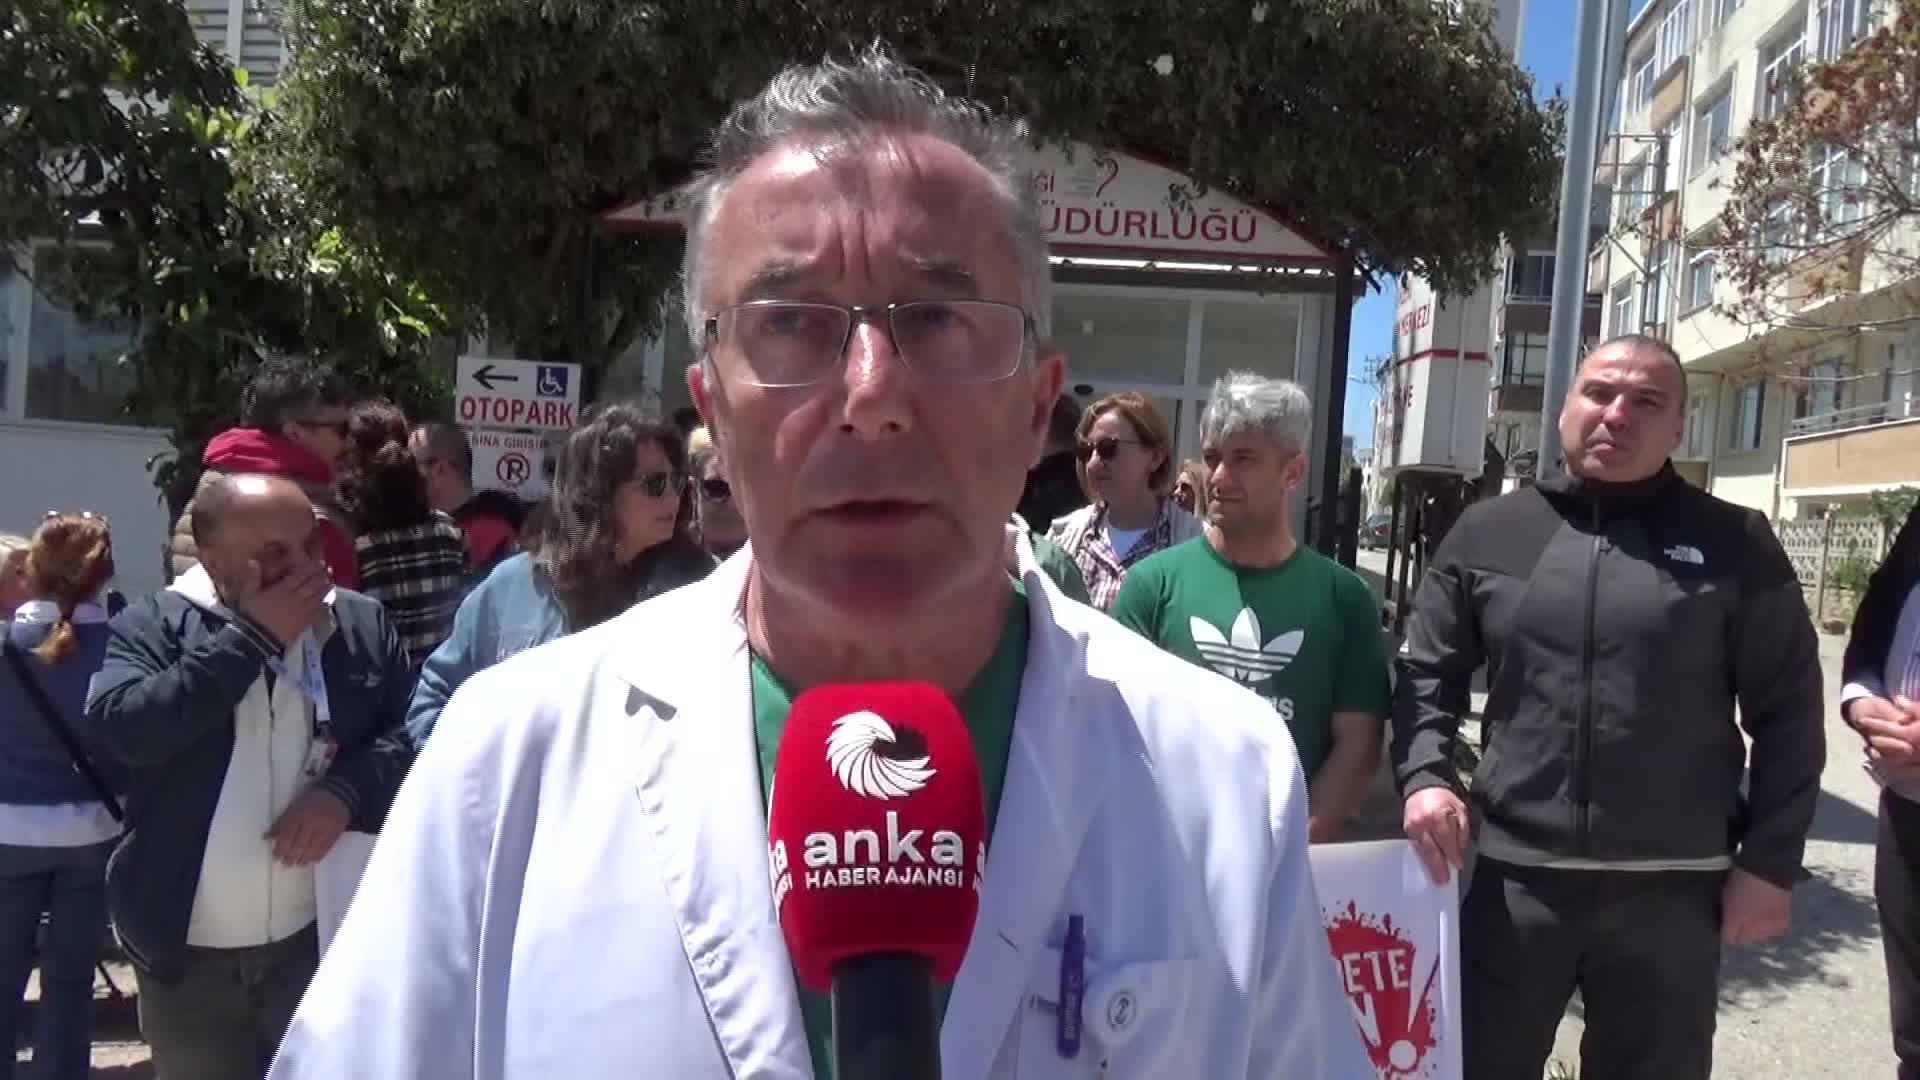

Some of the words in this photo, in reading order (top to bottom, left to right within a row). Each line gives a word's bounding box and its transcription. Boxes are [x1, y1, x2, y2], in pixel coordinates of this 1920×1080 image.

[1040, 199, 1257, 243] ÜDÜRLÜĞÜ
[461, 396, 573, 428] OTOPARK
[803, 811, 964, 867] anka
[806, 868, 881, 889] HABER
[884, 868, 964, 889] AJANSI
[1340, 949, 1409, 993] ETE
